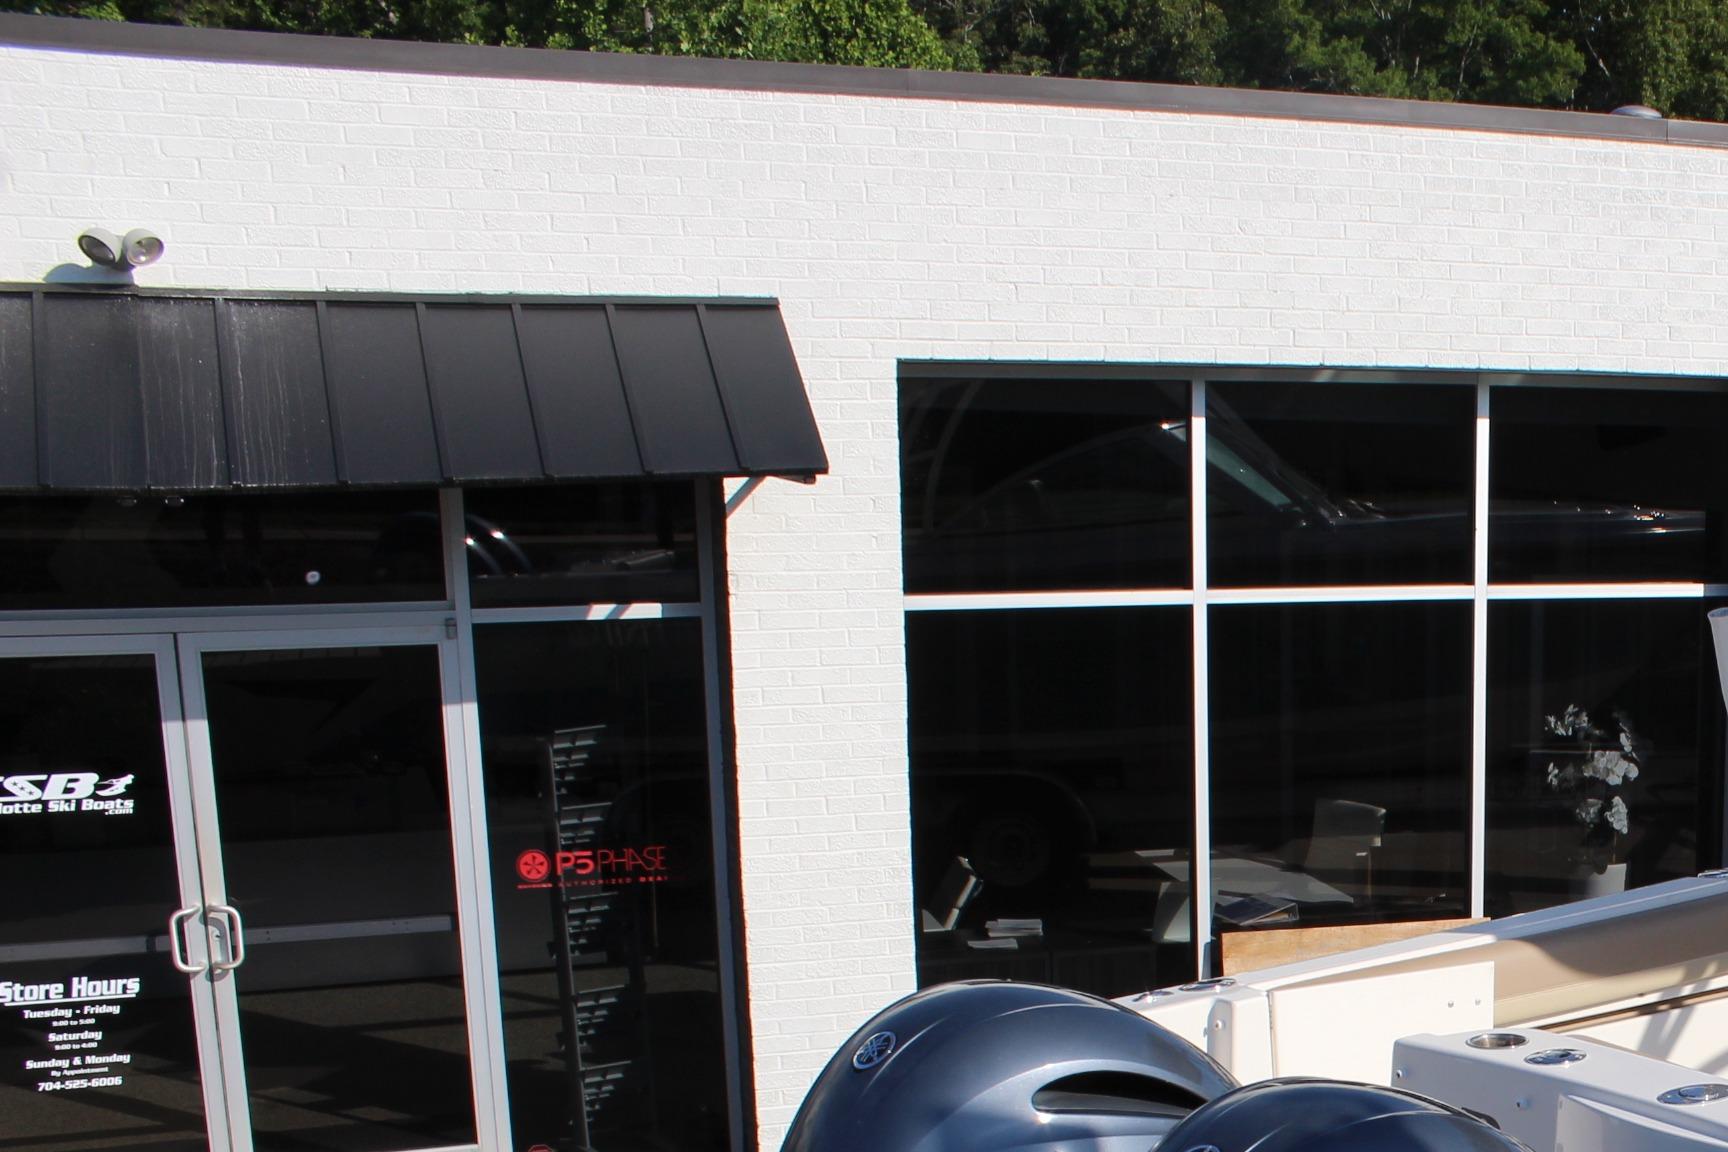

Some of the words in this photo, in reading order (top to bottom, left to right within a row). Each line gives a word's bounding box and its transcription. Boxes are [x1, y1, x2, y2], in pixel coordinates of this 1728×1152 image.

[0, 773, 99, 802] SB
[48, 800, 76, 812] Ski
[81, 799, 134, 811] Boats
[0, 981, 64, 1003] Store
[71, 976, 141, 998] Hours
[23, 1007, 73, 1019] Tuesday
[83, 1004, 121, 1014] Friday
[48, 1030, 102, 1042] Saturday
[26, 1058, 70, 1069] Sunday
[72, 1056, 82, 1066] &
[85, 1053, 131, 1064] Monday
[38, 1076, 123, 1092] 704-525-6006
